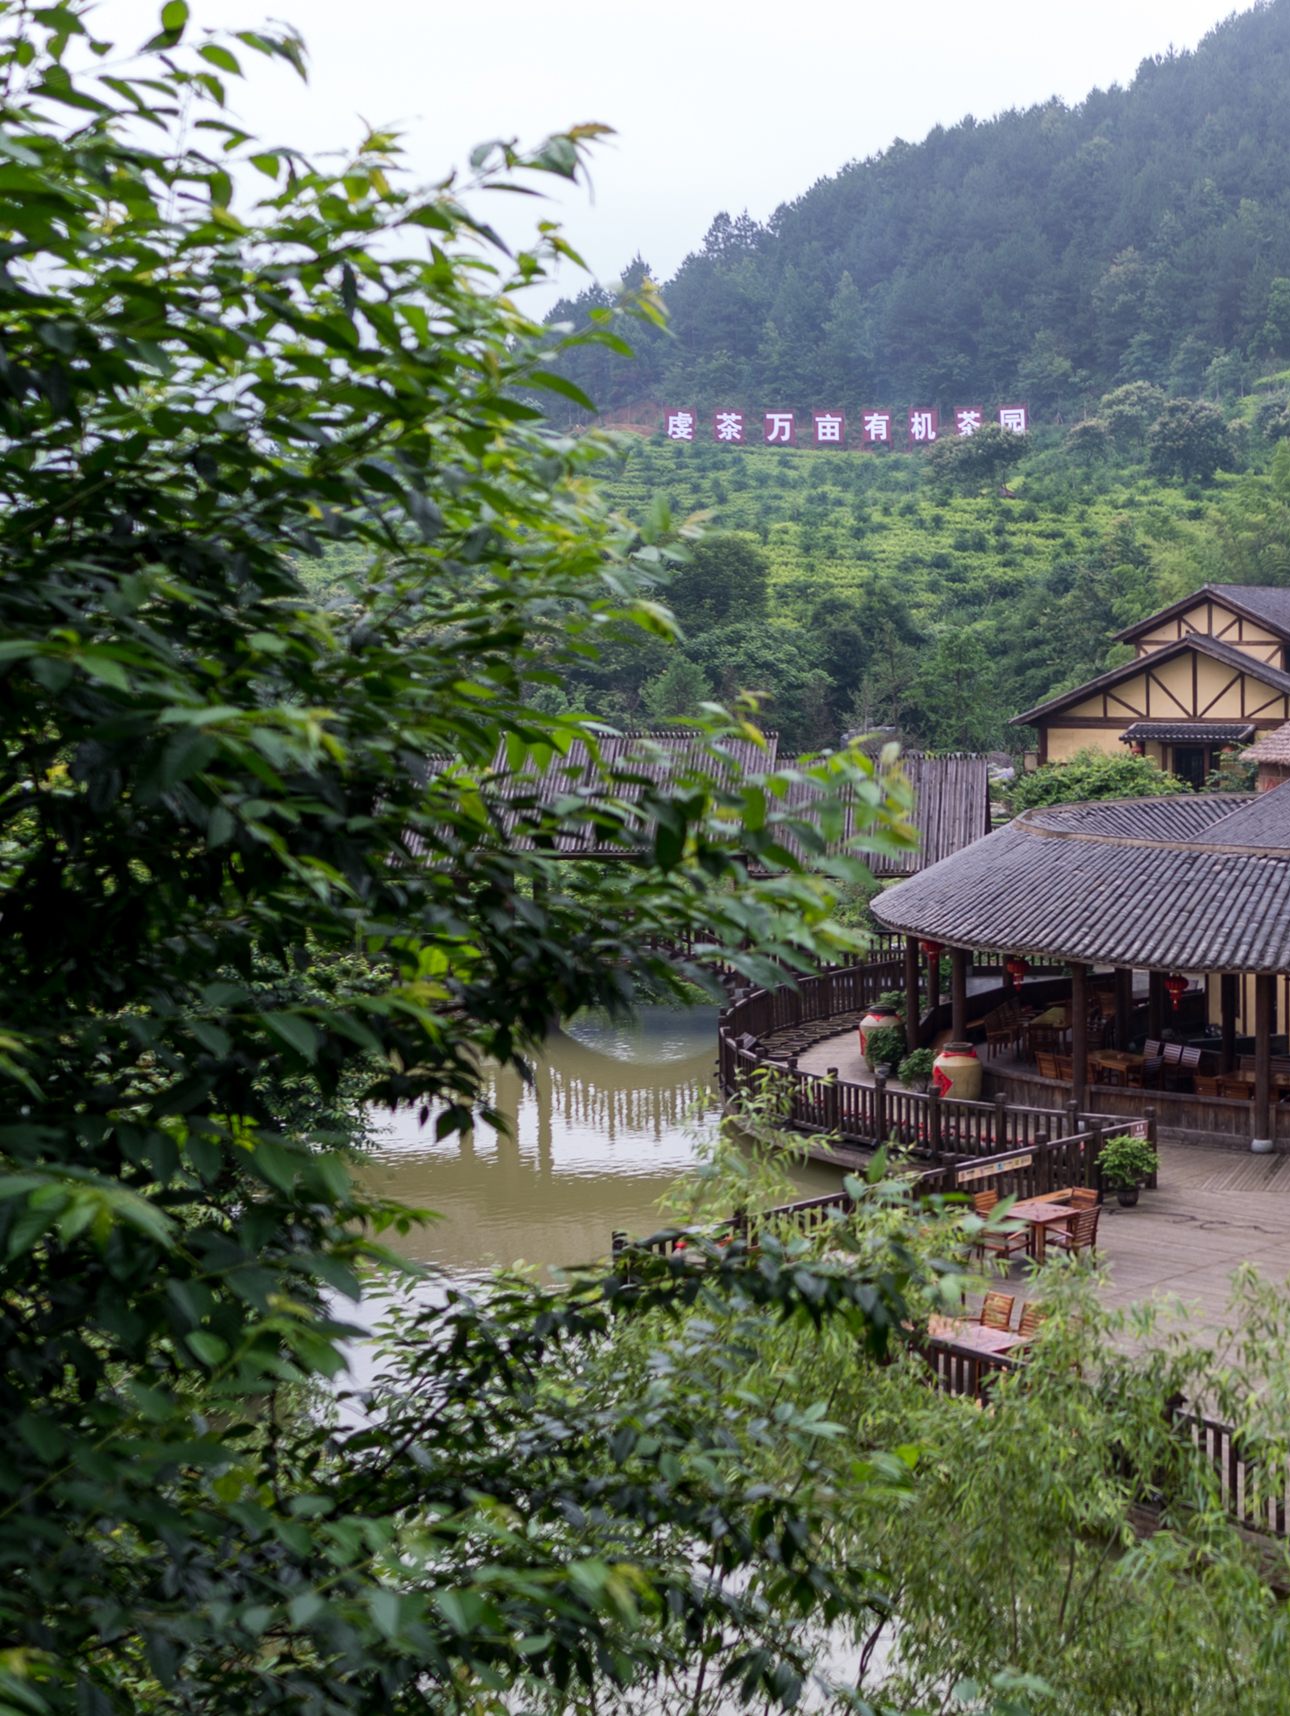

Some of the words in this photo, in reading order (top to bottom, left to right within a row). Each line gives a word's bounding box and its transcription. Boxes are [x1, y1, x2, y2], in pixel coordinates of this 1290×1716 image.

[667, 408, 1026, 441] 虔茶万亩有机茶园
